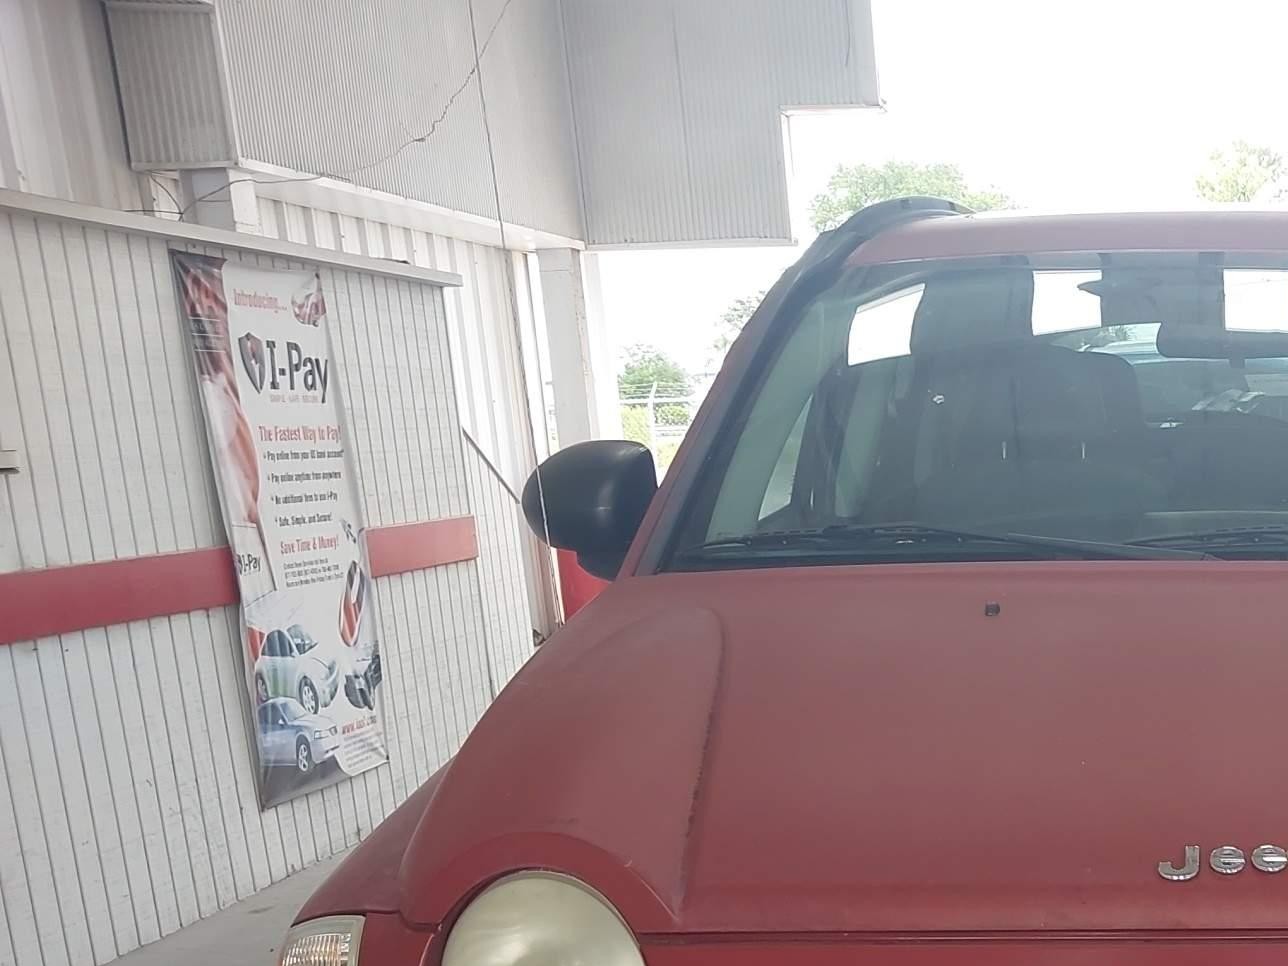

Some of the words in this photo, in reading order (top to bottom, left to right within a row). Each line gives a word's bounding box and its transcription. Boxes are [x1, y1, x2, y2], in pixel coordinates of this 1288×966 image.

[266, 340, 328, 404] I-Pay
[259, 426, 273, 441] The
[274, 426, 302, 441] Fastest
[302, 426, 316, 443] Way
[318, 426, 325, 441] to
[280, 541, 295, 555] Save
[296, 539, 312, 552] Time
